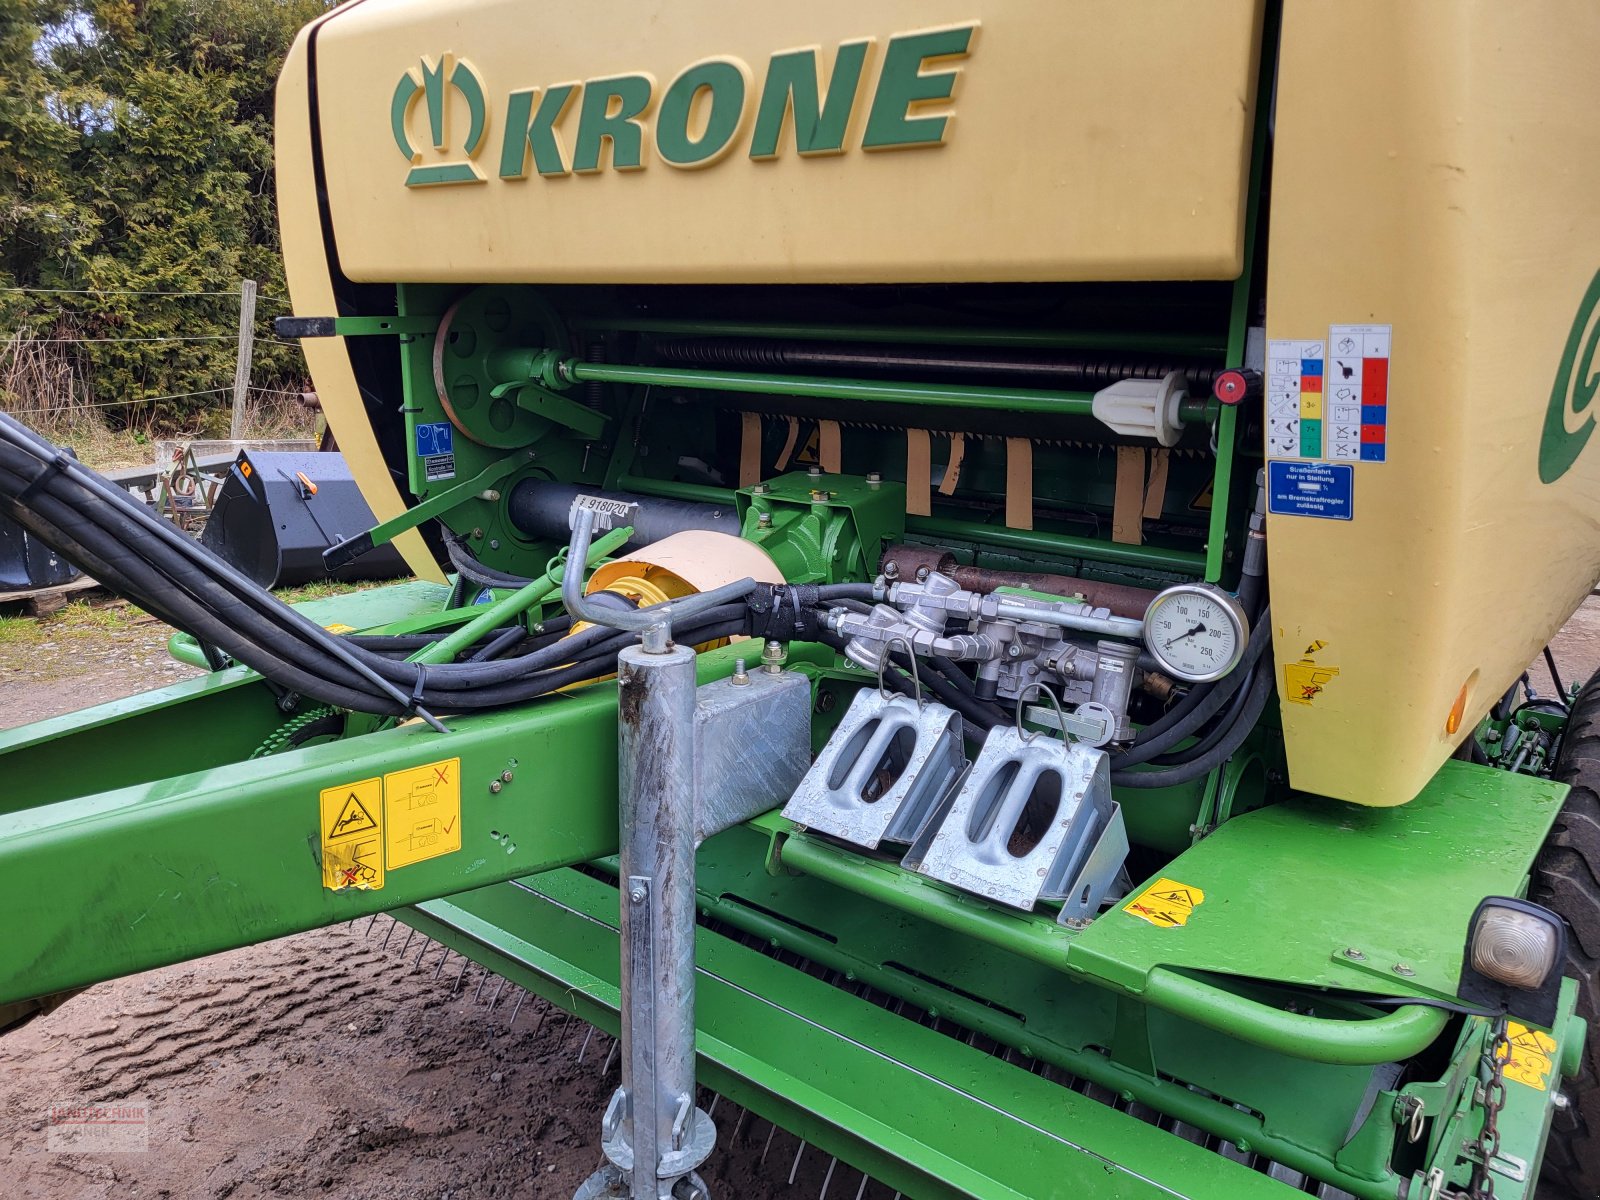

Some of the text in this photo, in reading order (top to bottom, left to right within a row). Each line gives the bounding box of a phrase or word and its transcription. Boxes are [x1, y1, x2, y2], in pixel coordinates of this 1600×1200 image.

[498, 20, 983, 184] KRONE
[1289, 466, 1331, 475] Straßenfahrt
[1306, 474, 1335, 483] Stellung
[1288, 494, 1344, 505] Bremskraftregler
[588, 499, 627, 514] 918020
[1296, 502, 1324, 510] zulässig
[1176, 606, 1188, 615] 100
[1198, 609, 1210, 619] 150
[1163, 621, 1172, 629] 50
[1209, 629, 1221, 638] 200
[1200, 647, 1213, 656] 250
